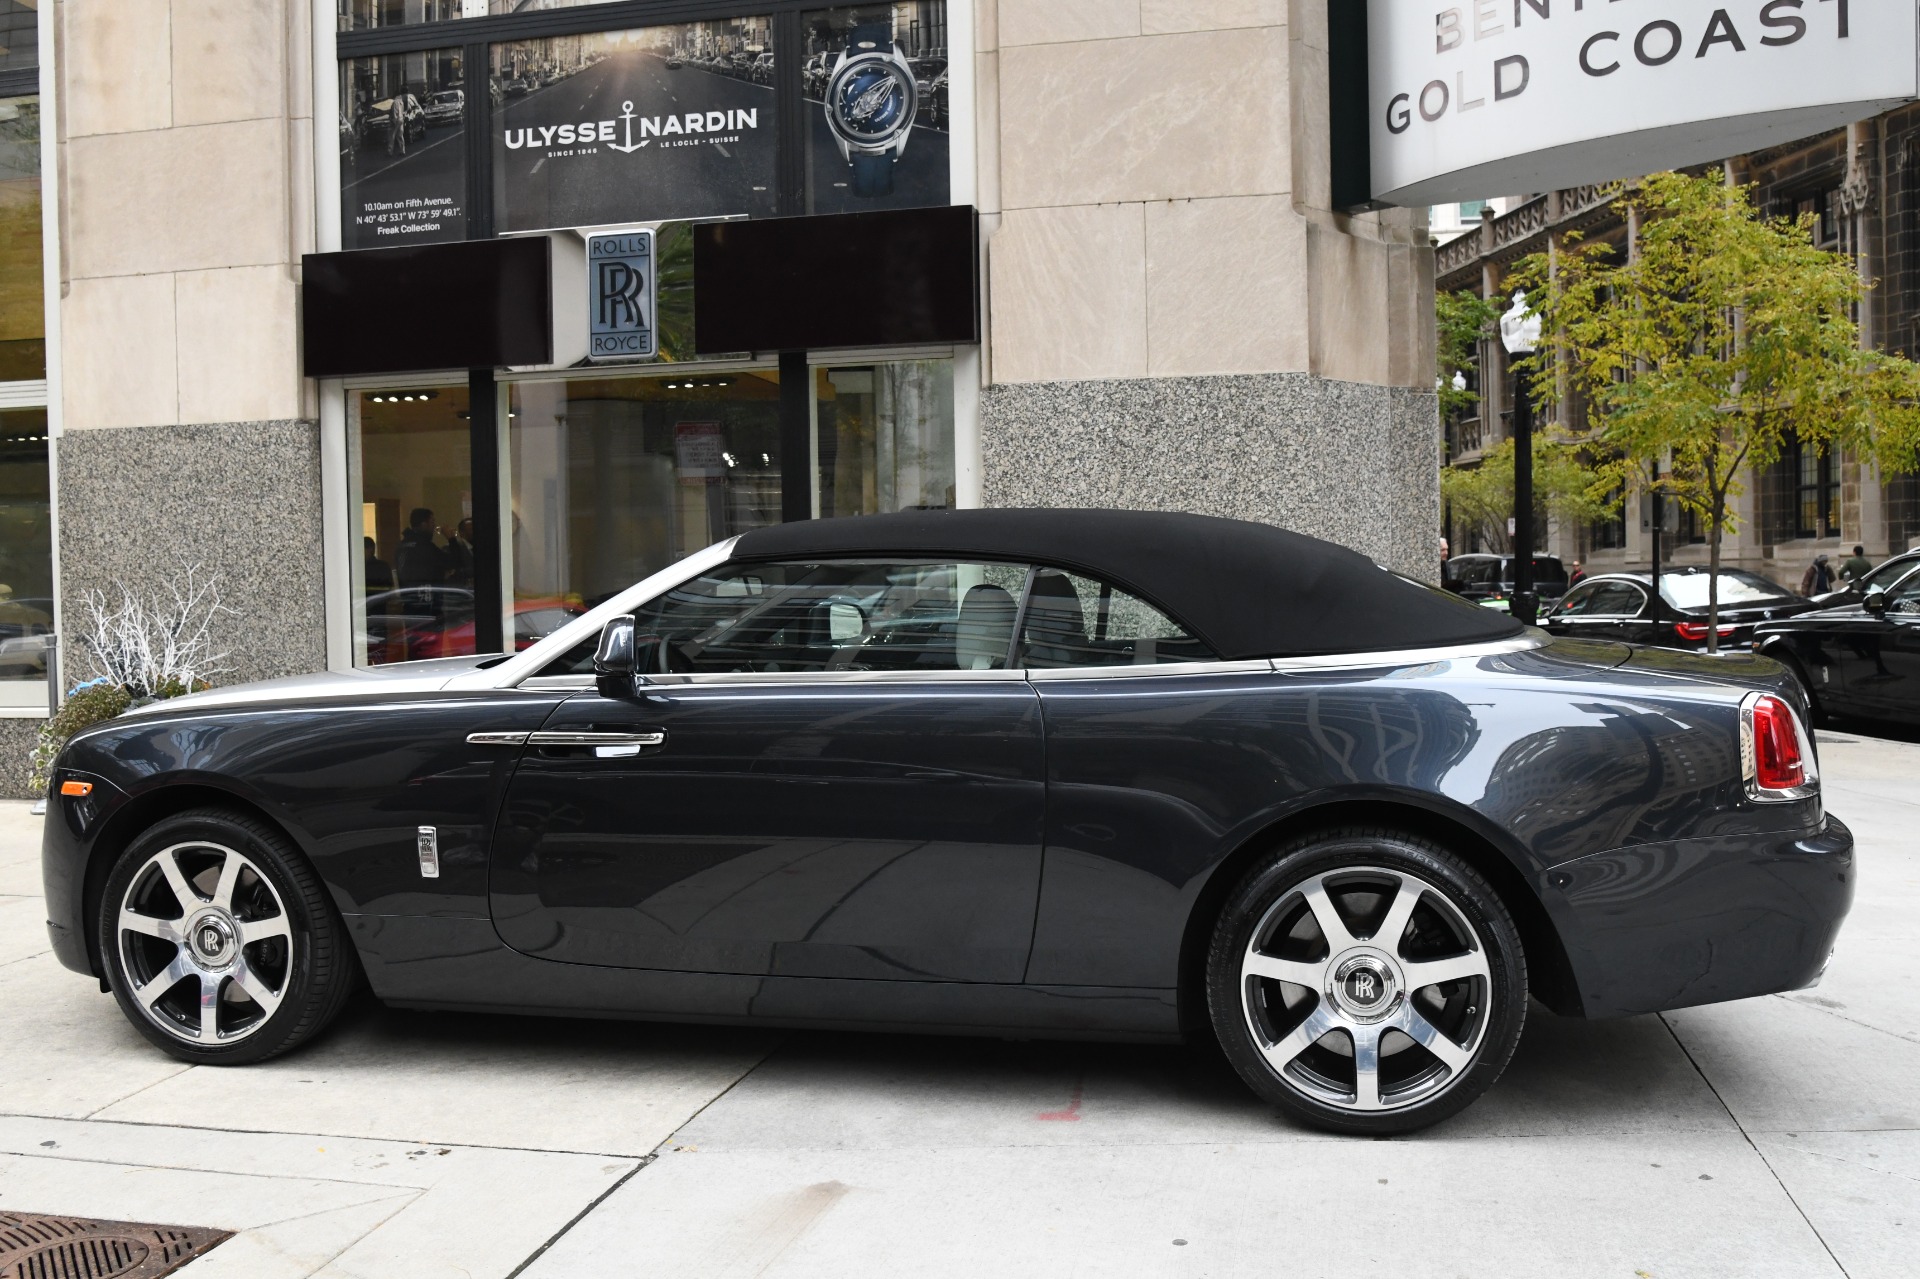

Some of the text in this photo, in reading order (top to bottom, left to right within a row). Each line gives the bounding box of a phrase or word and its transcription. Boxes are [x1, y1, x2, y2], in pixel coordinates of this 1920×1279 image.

[1386, 0, 1849, 134] GOLD COAST
[505, 108, 757, 149] ULYSSE NARDIN
[673, 139, 699, 147] LOCLE
[709, 136, 739, 144] SUISSE
[548, 149, 573, 157] SINCE
[364, 202, 392, 211] 10.10am
[405, 199, 422, 208] Fifth
[424, 197, 453, 206] Avenue.
[356, 216, 363, 224] N
[408, 211, 416, 220] W
[377, 222, 440, 235] Freak Collection
[593, 237, 646, 254] ROLLS
[595, 335, 647, 351] ROYCE
